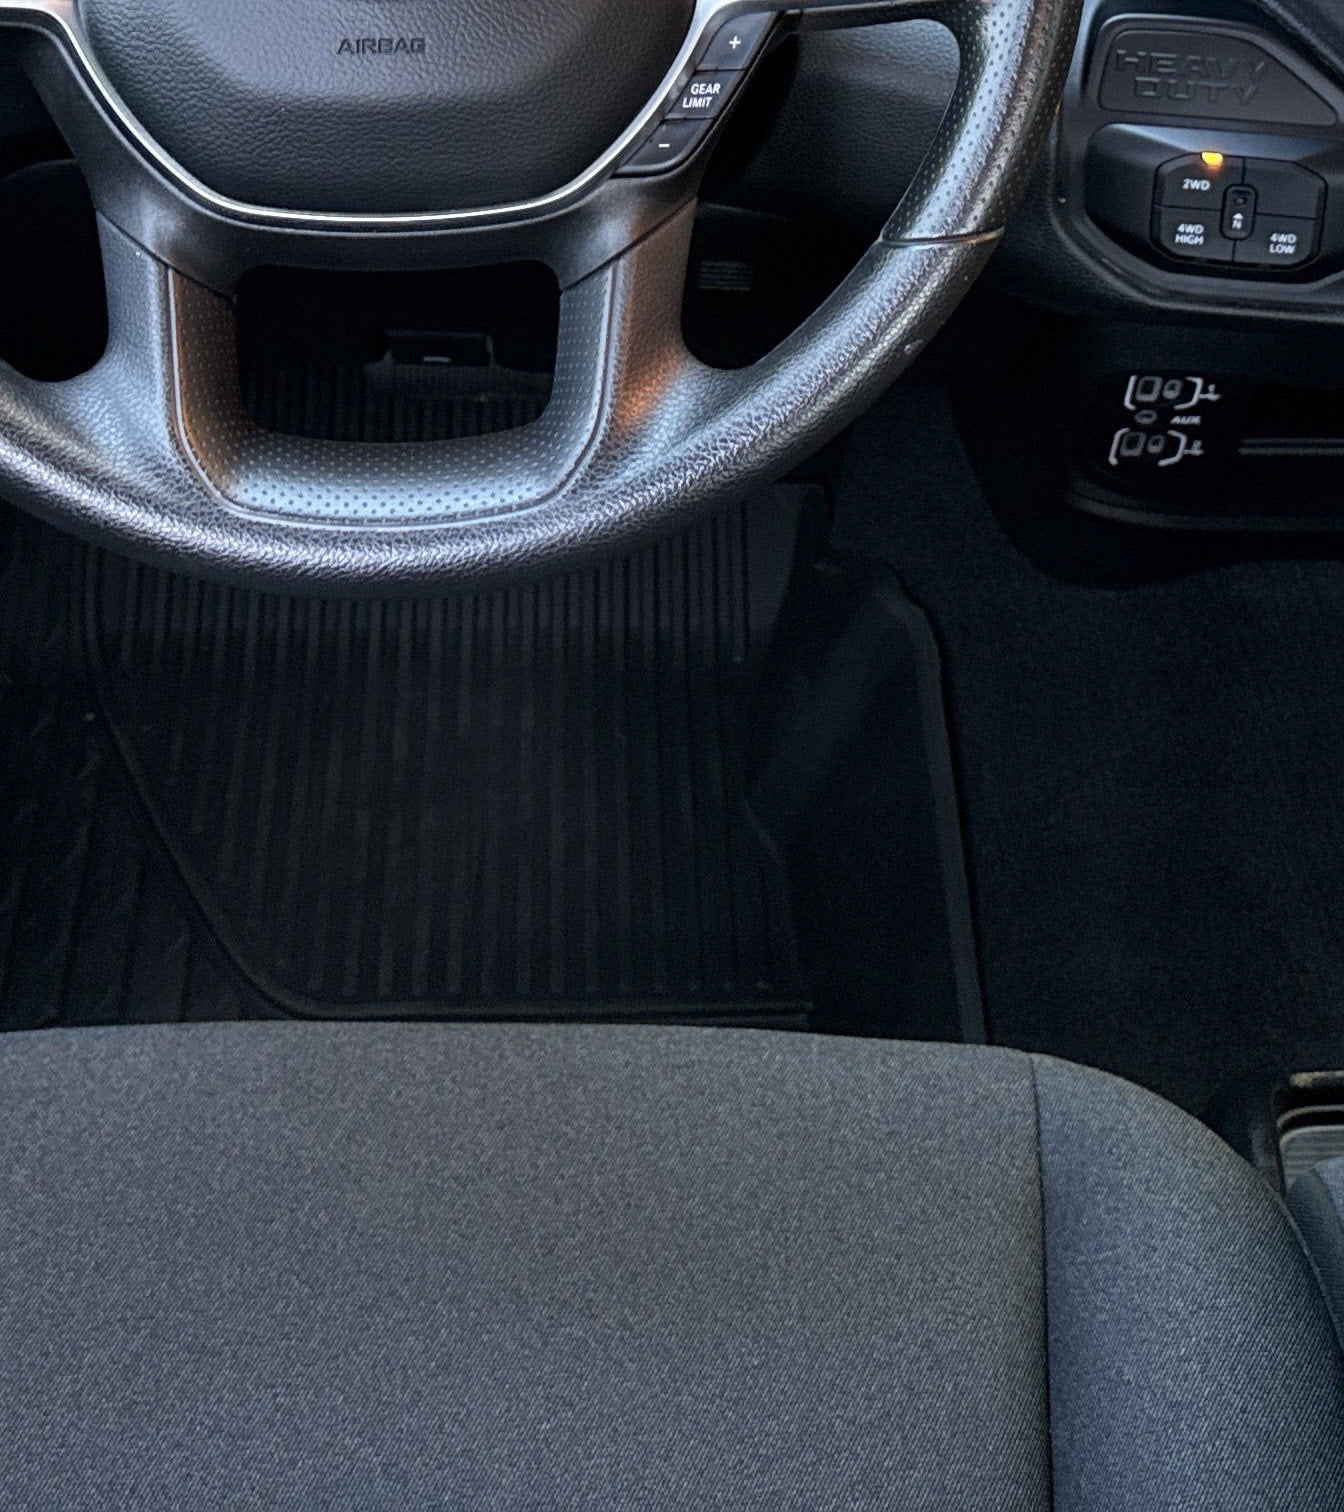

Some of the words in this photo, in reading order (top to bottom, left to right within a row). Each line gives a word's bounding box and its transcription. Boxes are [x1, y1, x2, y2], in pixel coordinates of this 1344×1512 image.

[336, 37, 427, 55] AIRBAG
[1116, 49, 1266, 77] HEAVY
[690, 83, 721, 95] GEAR
[1134, 76, 1259, 105] DUTY
[682, 97, 712, 108] LIMIT
[1182, 178, 1211, 191] 2WD
[1177, 223, 1204, 235] 4WD
[1232, 219, 1242, 229] N
[1175, 233, 1204, 246] HIGH
[1269, 233, 1297, 245] 4WD
[1269, 243, 1296, 254] LOW
